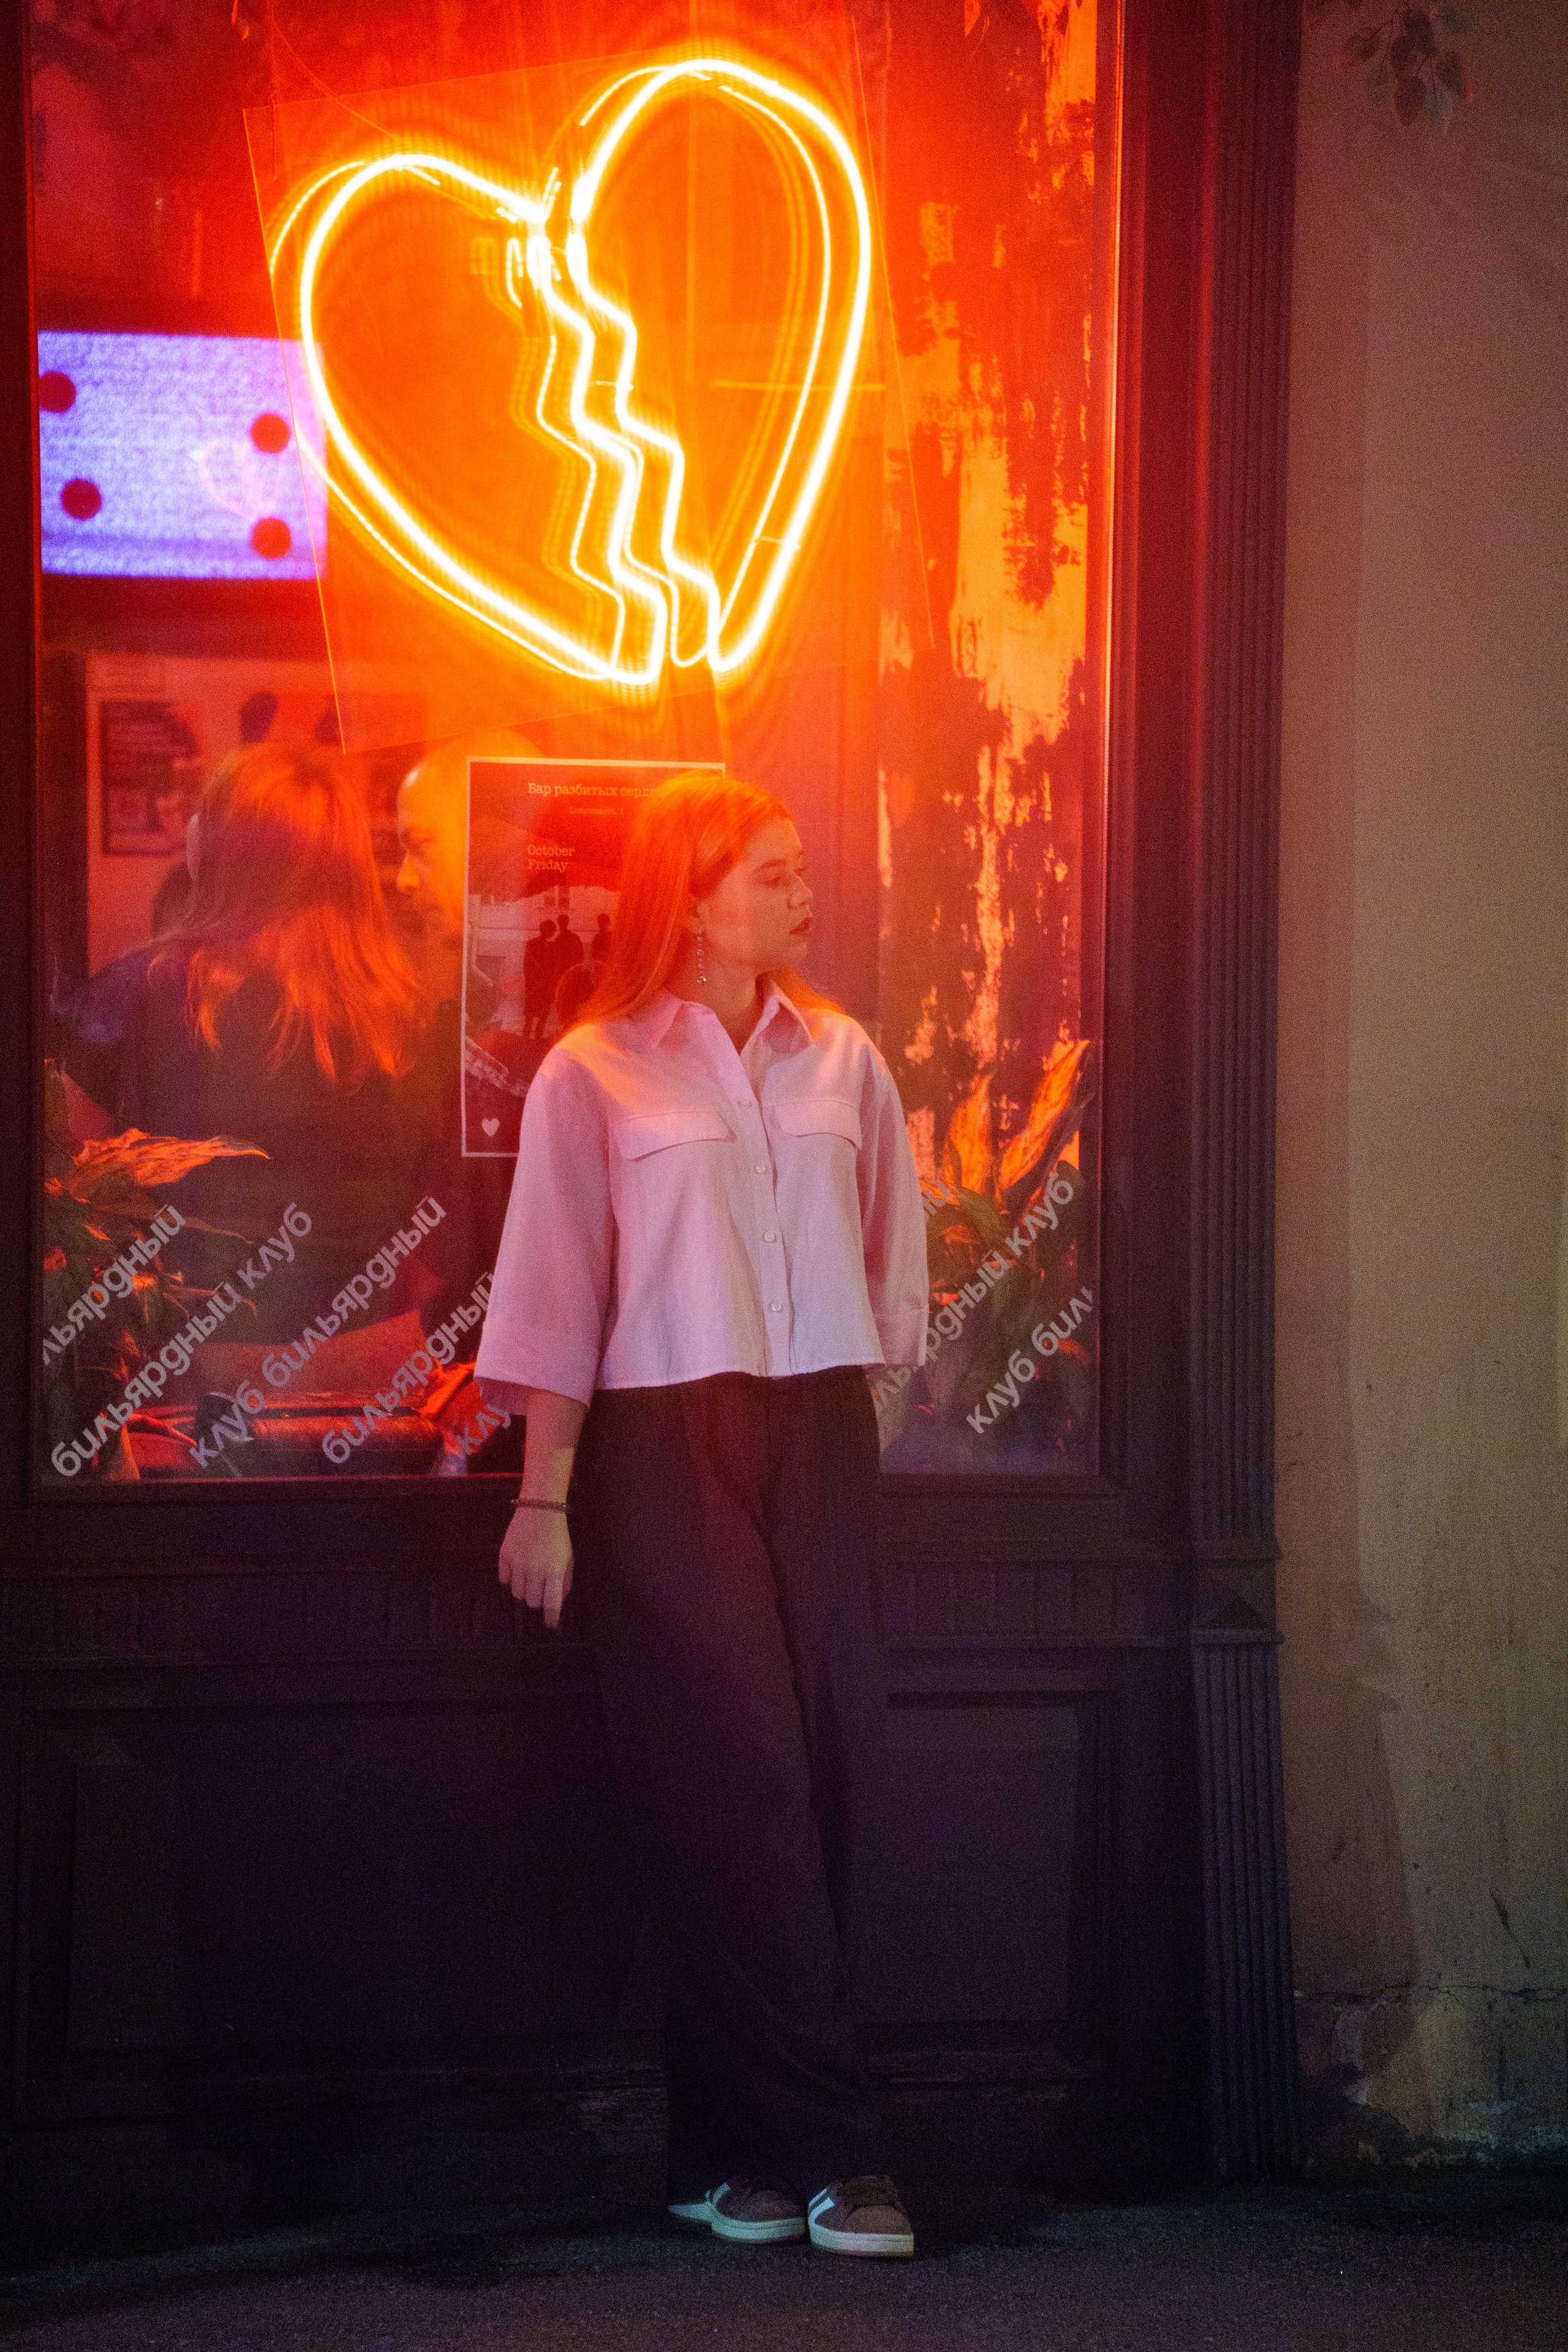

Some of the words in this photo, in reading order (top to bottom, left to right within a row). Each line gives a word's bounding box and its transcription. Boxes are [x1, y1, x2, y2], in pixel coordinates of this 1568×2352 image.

[527, 783, 551, 796] Бар
[554, 783, 616, 797] разбитых
[620, 788, 657, 799] серд
[527, 845, 575, 856] October
[527, 859, 568, 873] Friday
[1005, 1172, 1073, 1256] клуб
[51, 1281, 243, 1476] бильярдный
[237, 1203, 311, 1289] клуб
[189, 1381, 265, 1467] клуб
[262, 1197, 446, 1387] бильярдный
[966, 1350, 1035, 1433] клуб
[456, 1403, 511, 1455] клу
